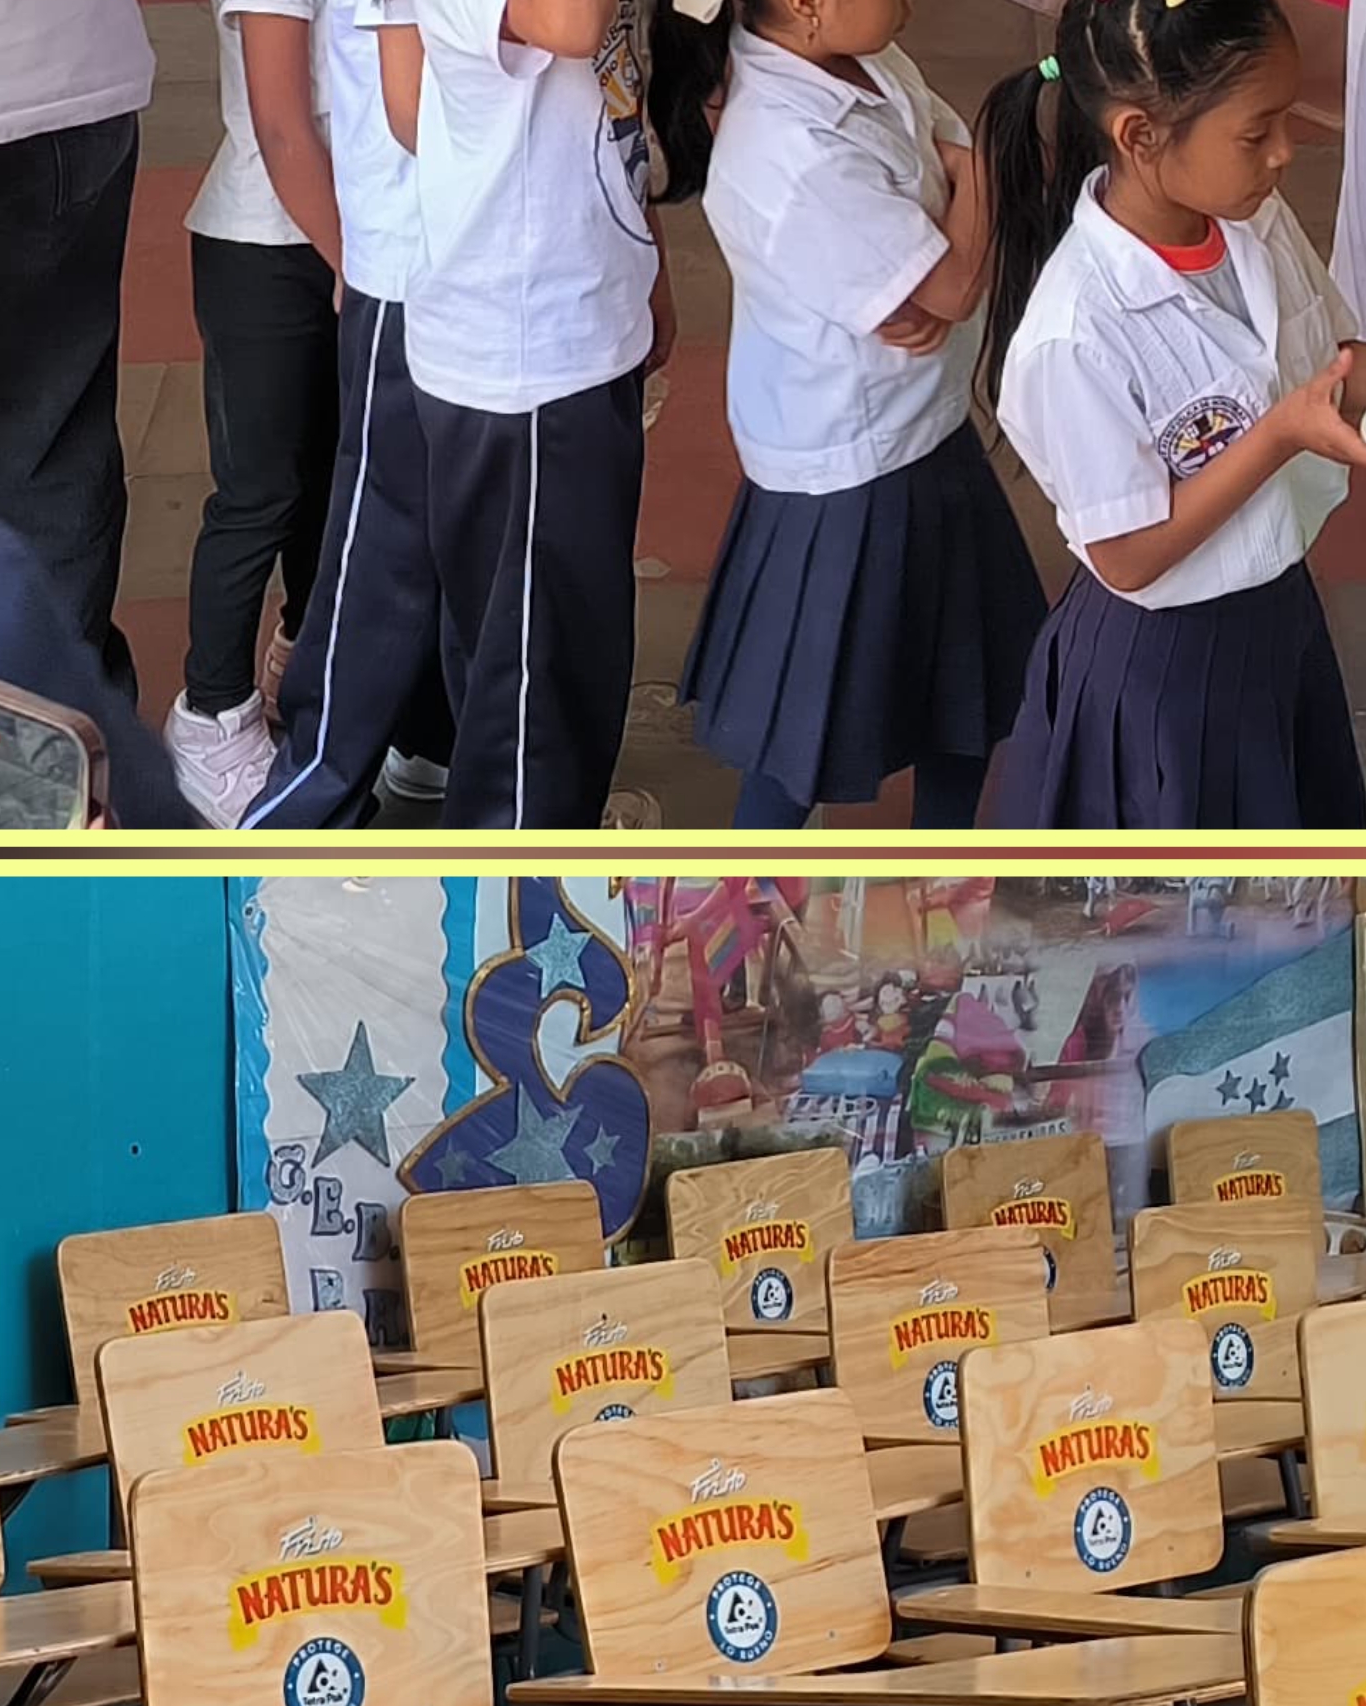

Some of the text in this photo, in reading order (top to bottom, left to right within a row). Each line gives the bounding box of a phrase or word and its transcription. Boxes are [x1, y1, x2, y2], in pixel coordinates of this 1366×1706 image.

[725, 1221, 807, 1260] NATURA'S
[130, 1293, 230, 1333] NATURA'S
[1188, 1275, 1268, 1312] NATURA'S
[895, 1309, 990, 1349] NATURA'S
[557, 1353, 663, 1395] NATURA'S
[189, 1408, 308, 1457] NATURA'S
[1040, 1423, 1150, 1475] NATURA'S
[658, 1506, 794, 1561] NATURA'S
[238, 1565, 392, 1625] NATURA'S
[710, 1573, 762, 1598] PROTEGE
[293, 1640, 349, 1666] PROTEGE
[737, 1629, 773, 1661] BUENO
